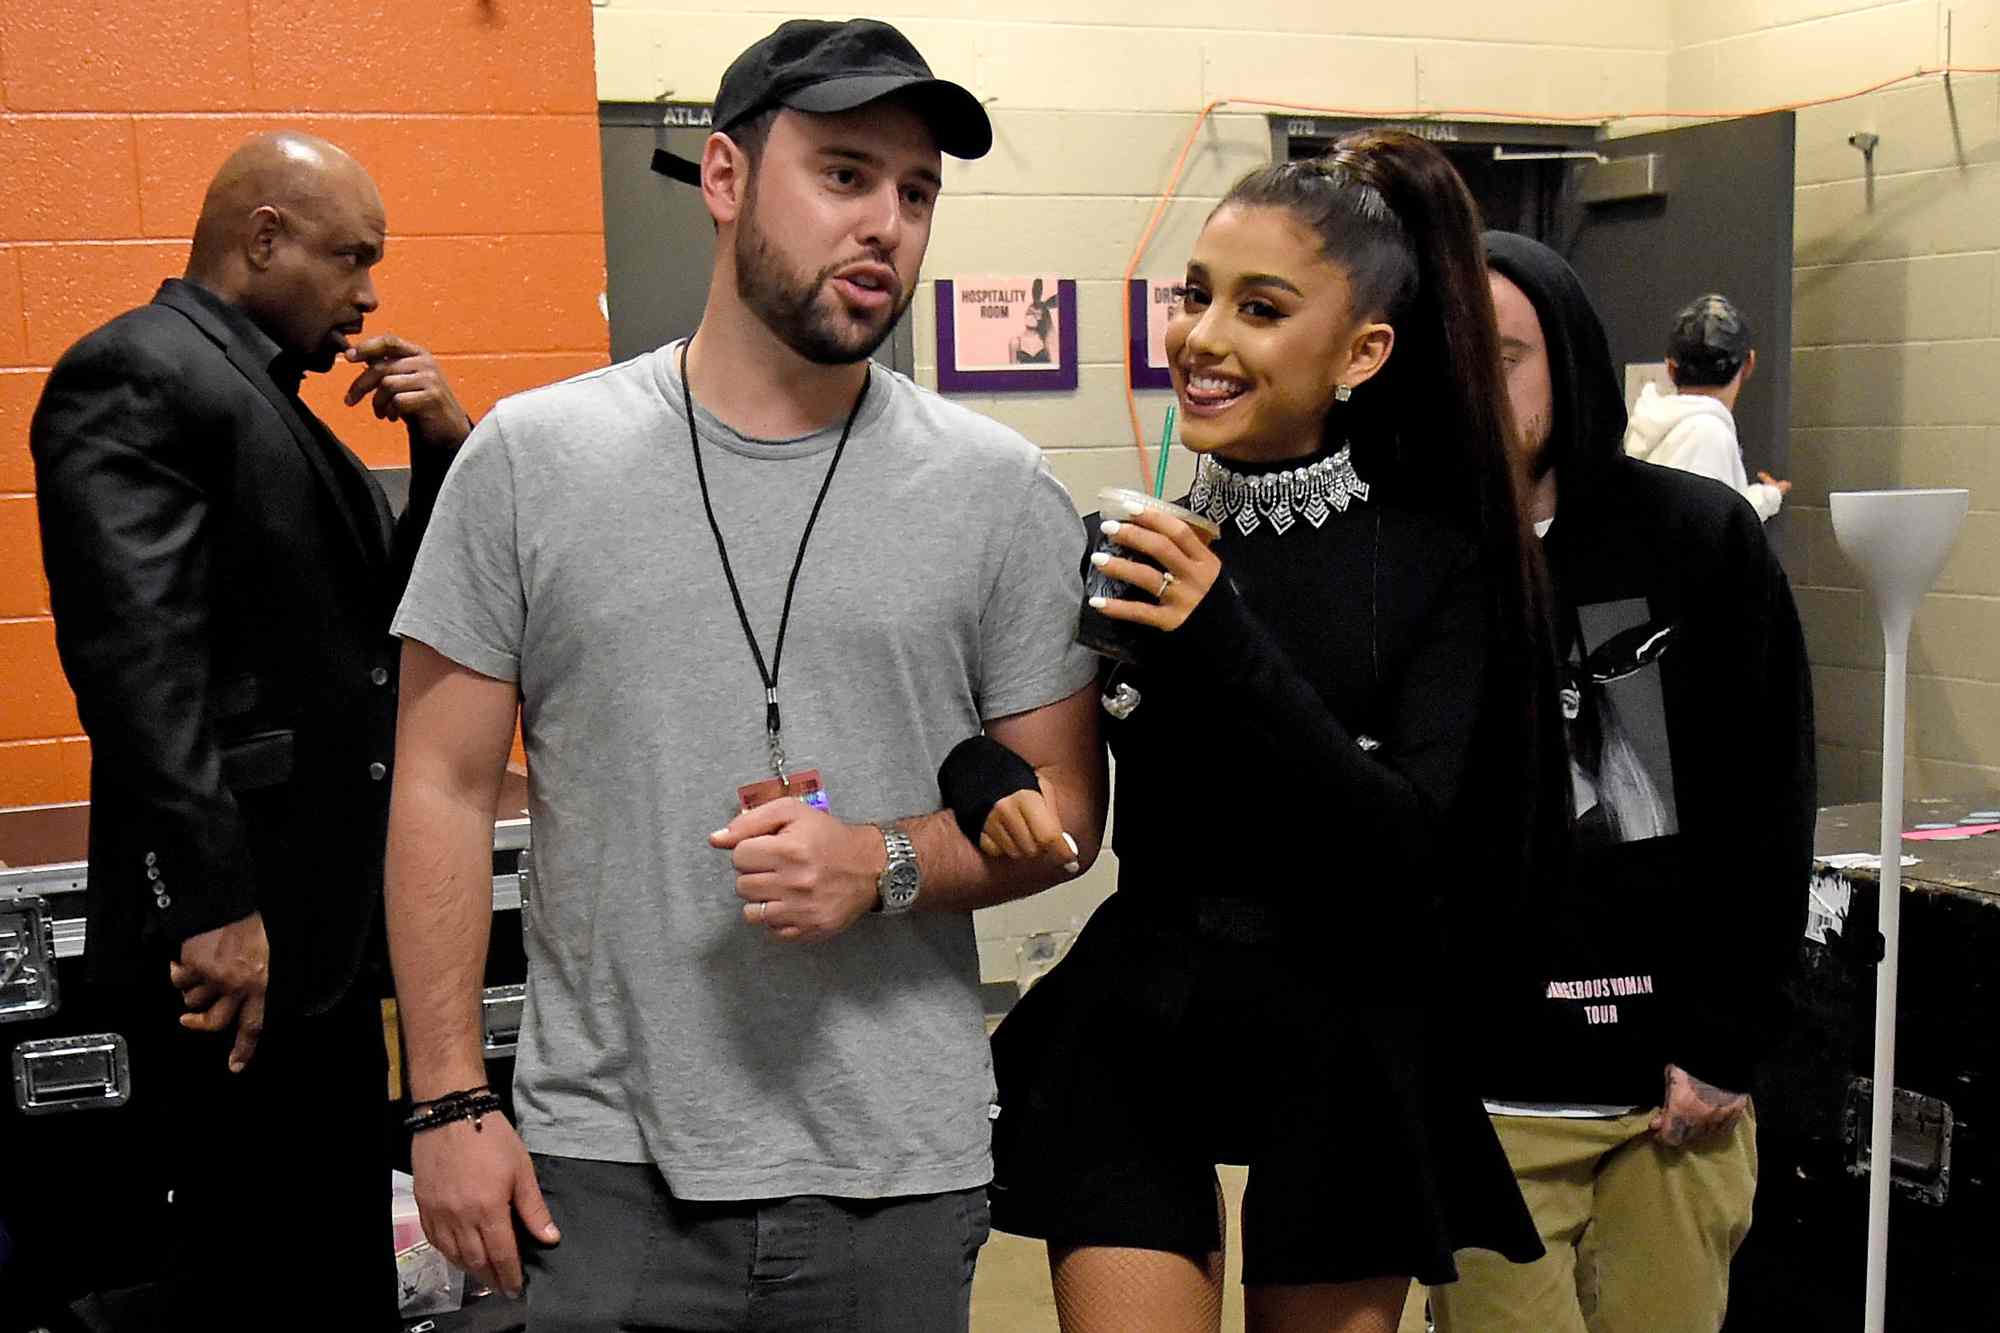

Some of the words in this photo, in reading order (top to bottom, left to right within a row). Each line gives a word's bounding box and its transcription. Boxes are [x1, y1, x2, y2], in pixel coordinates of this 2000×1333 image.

[663, 107, 713, 125] ATLA
[961, 289, 1026, 303] HOSPITALITY
[980, 304, 1009, 319] ROOM
[1584, 1004, 1619, 1024] TOUR
